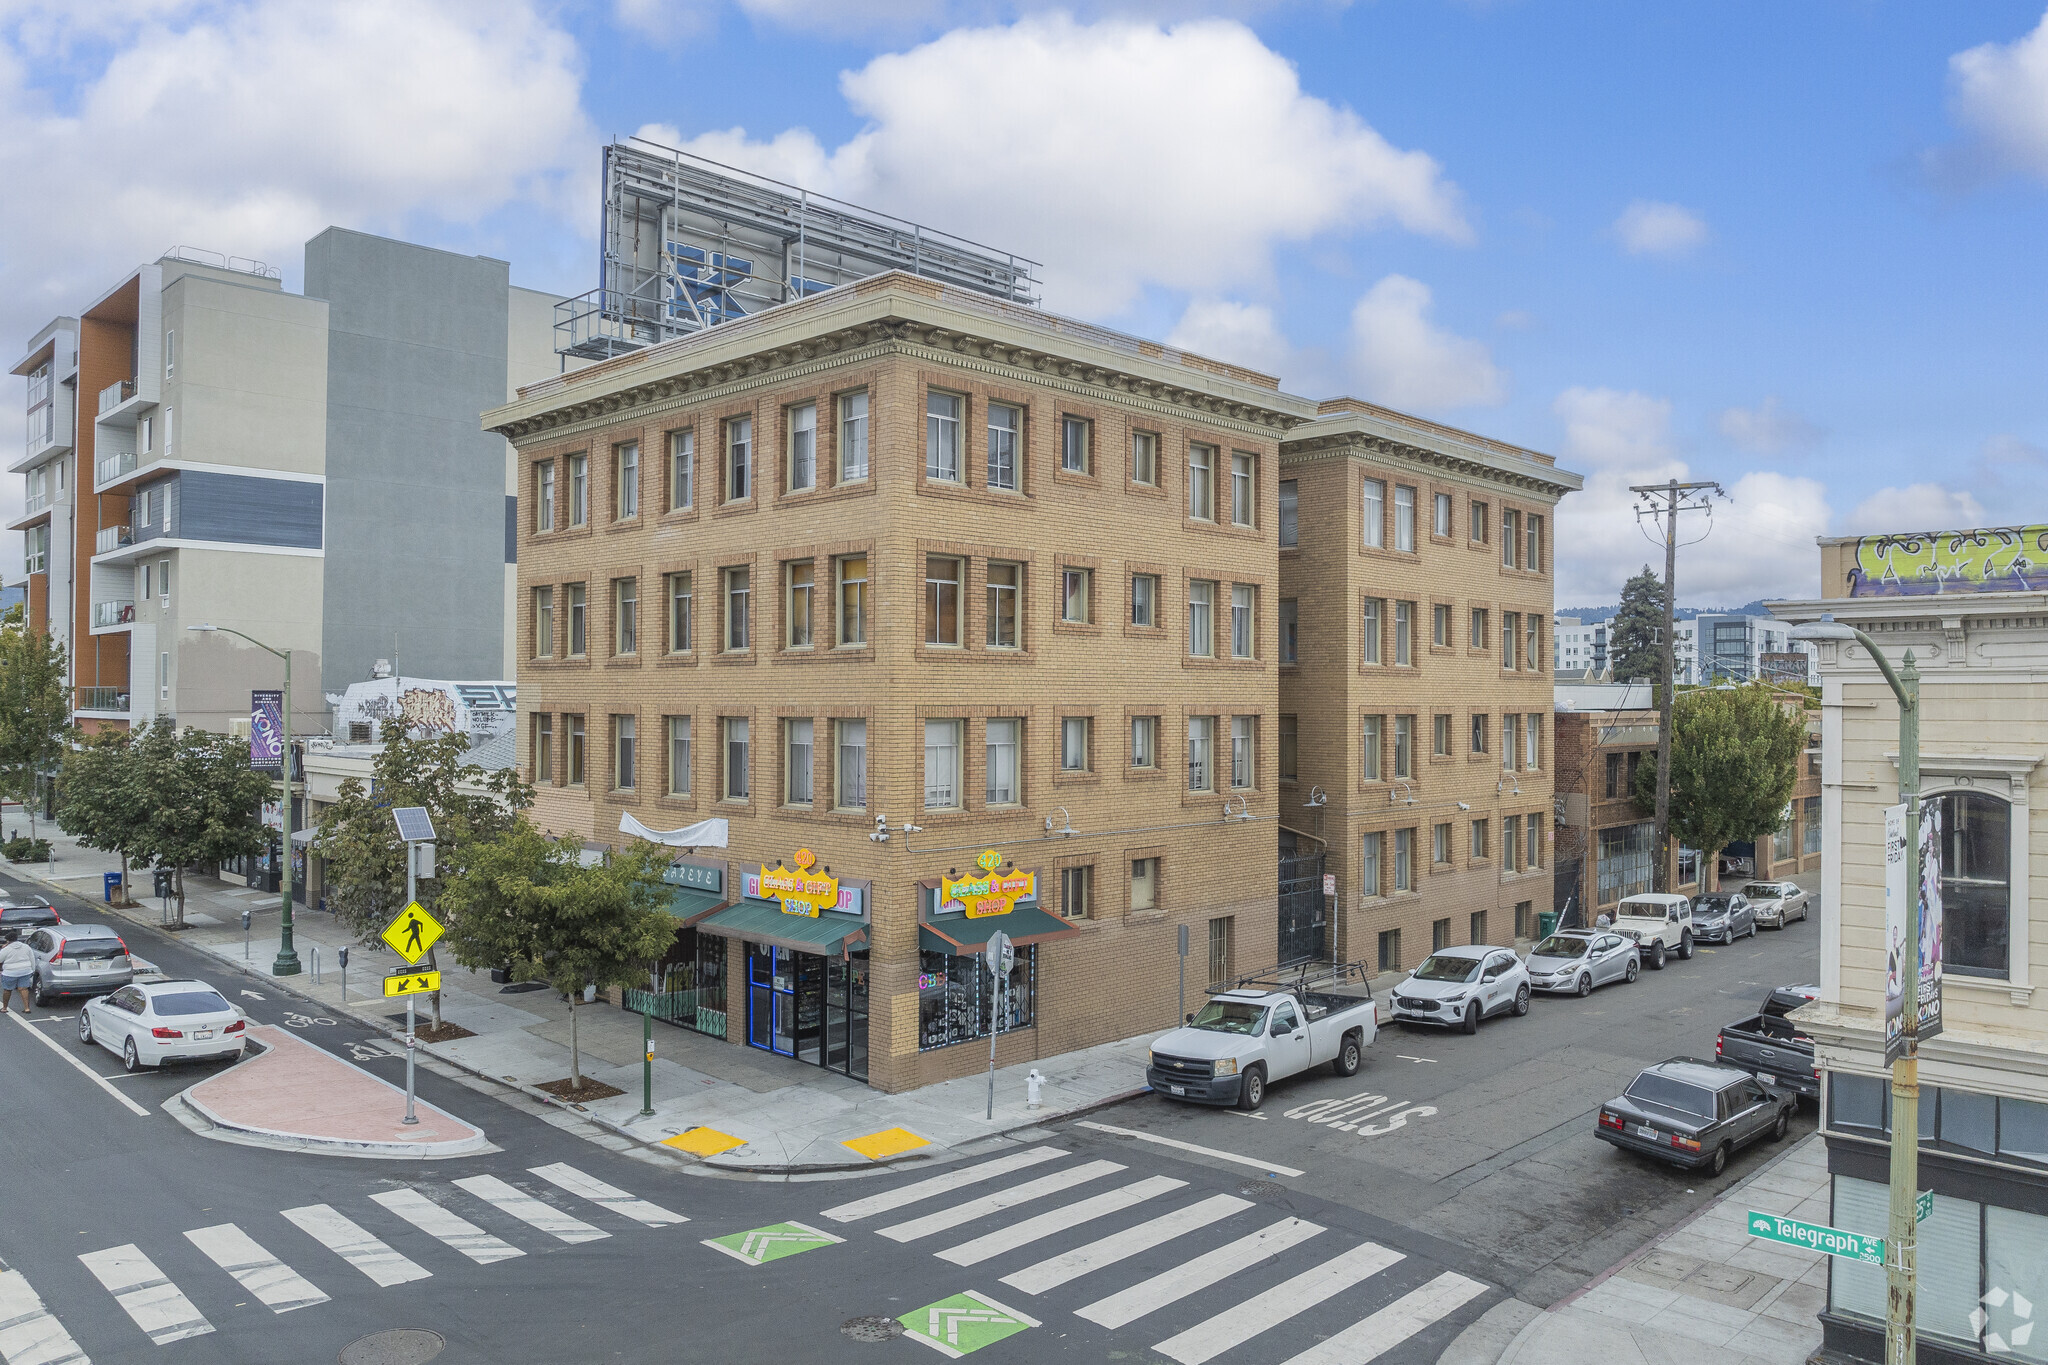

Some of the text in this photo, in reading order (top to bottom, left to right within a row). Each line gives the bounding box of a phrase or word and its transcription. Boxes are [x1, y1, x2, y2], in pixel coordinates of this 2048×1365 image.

[251, 708, 282, 756] KONO
[796, 851, 813, 866] 420
[979, 853, 1001, 868] 420
[749, 877, 853, 909] GI OP
[763, 875, 831, 896] GLASS & GIFT
[950, 877, 1028, 898] GLASS & GIFT
[784, 898, 812, 916] SHOP
[976, 898, 1007, 915] SHOP
[919, 972, 946, 989] CBD
[1918, 981, 1934, 995] FIRST
[1886, 1011, 1904, 1041] KON
[1774, 1218, 1878, 1253] Telegraph AVE
